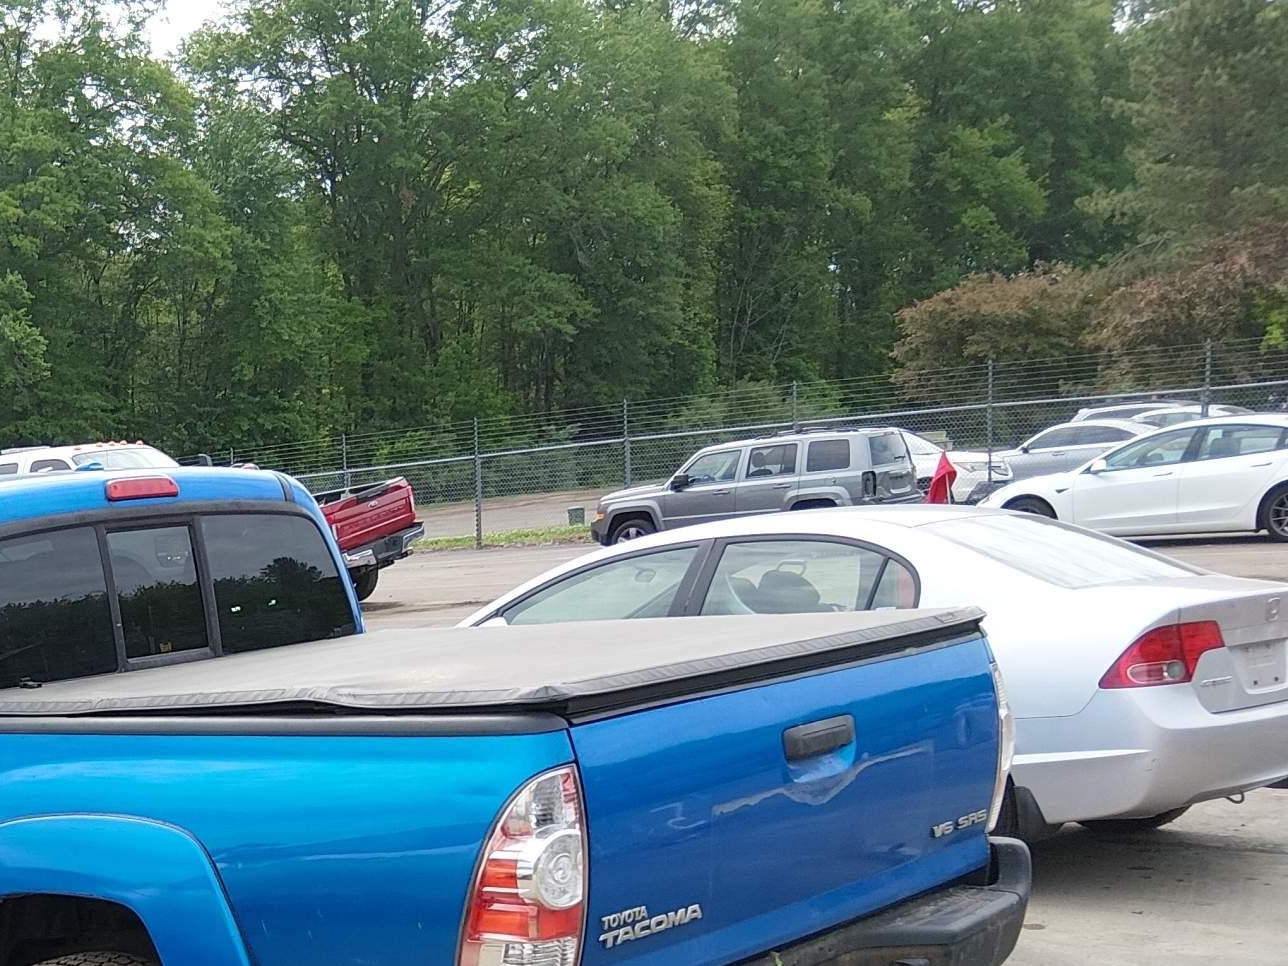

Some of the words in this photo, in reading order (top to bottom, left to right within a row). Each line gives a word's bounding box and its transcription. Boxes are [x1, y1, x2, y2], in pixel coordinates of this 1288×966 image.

[931, 820, 954, 838] V6
[598, 903, 703, 949] TACOMA
[601, 905, 648, 930] TOYOTA
